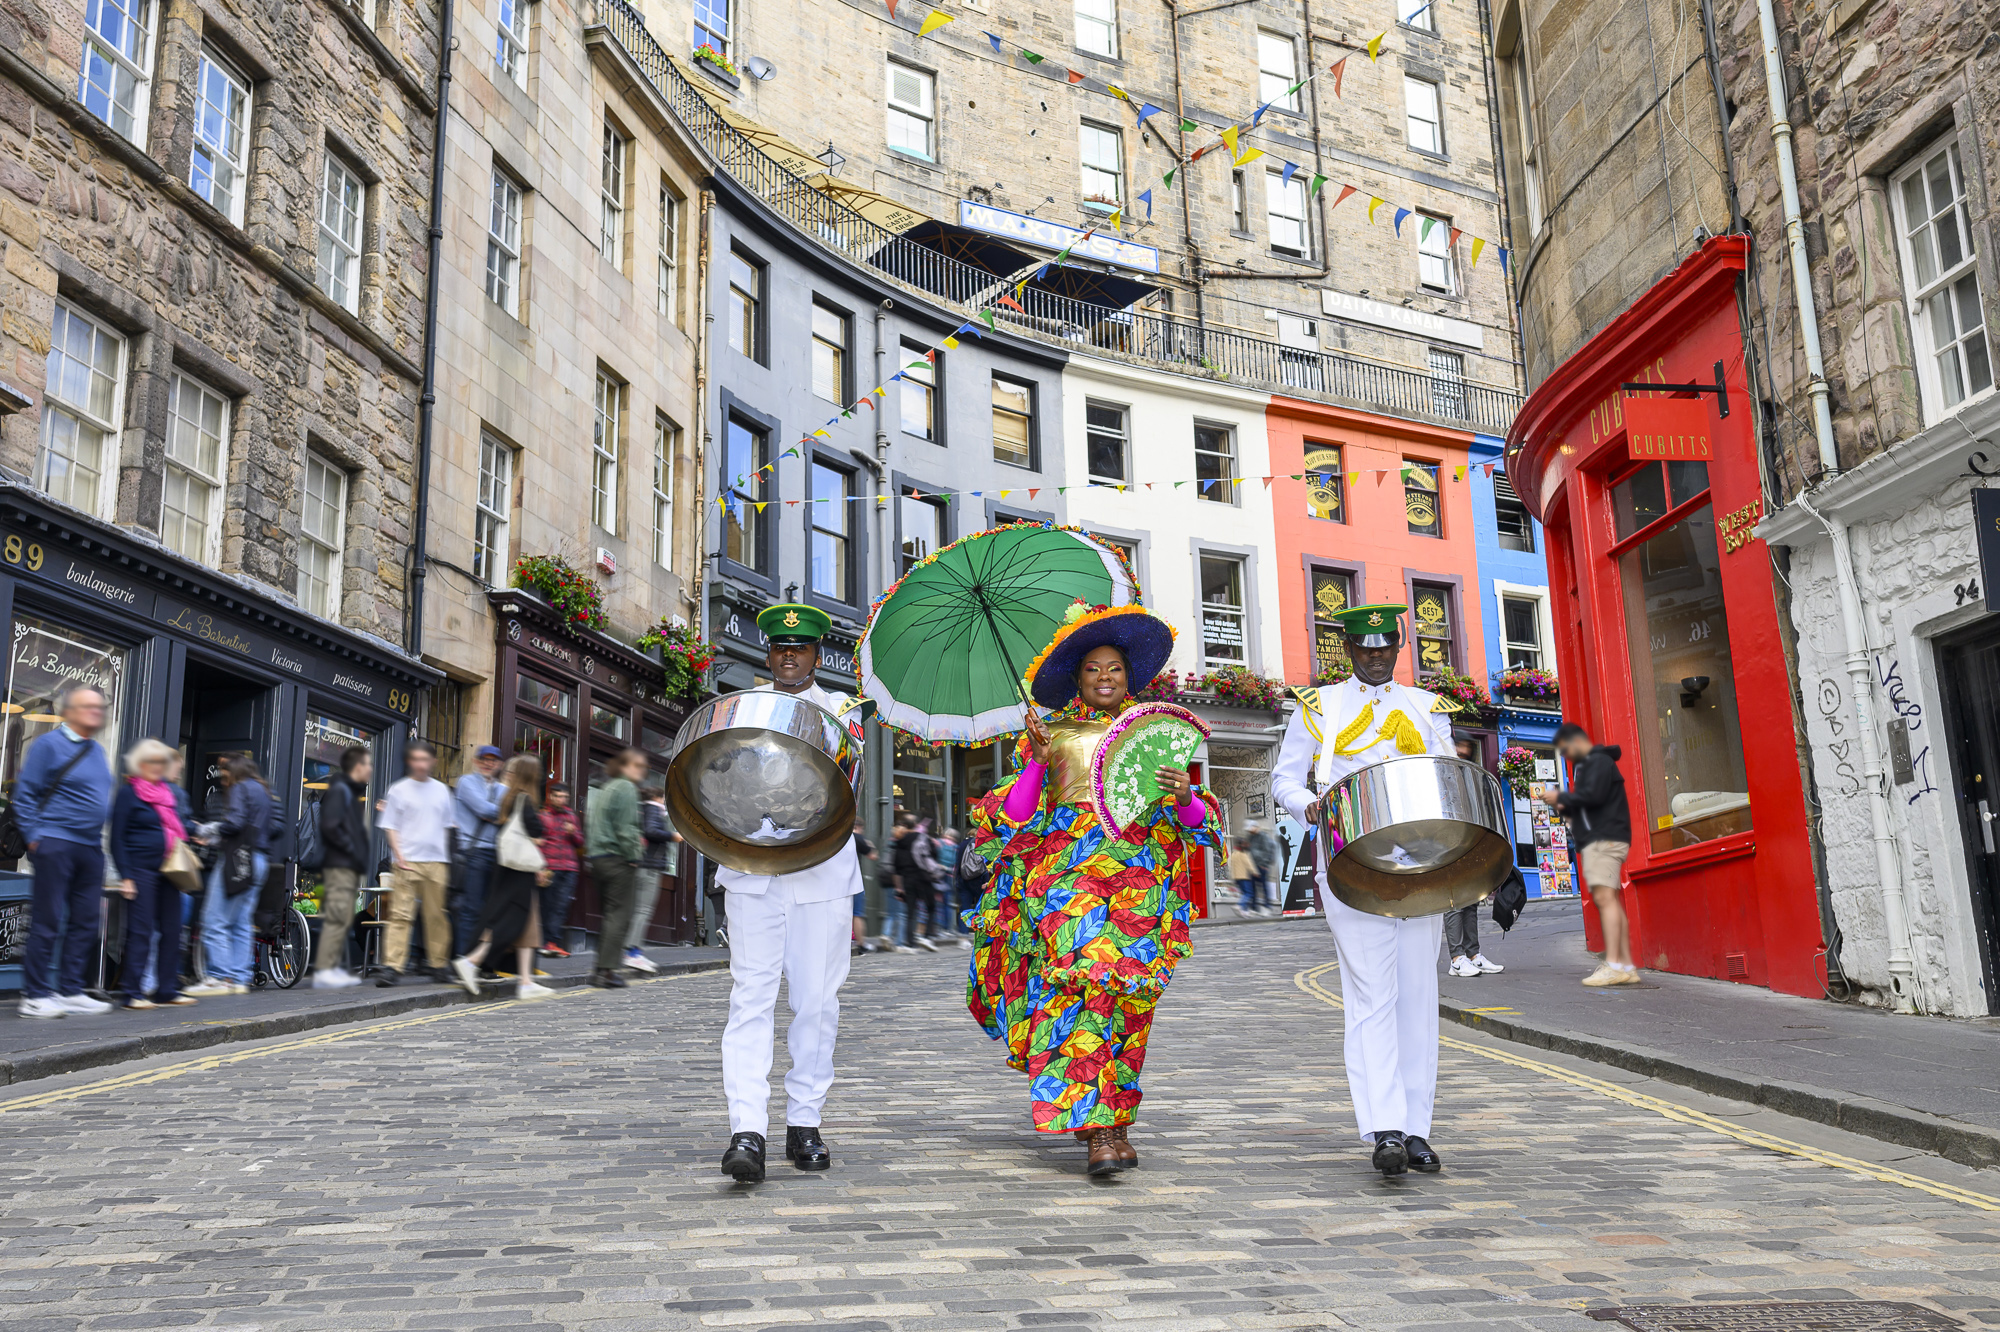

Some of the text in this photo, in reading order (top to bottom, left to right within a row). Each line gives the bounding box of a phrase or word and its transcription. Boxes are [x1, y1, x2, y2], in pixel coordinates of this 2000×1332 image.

[885, 211, 902, 221] THE
[885, 214, 914, 228] CASTLE
[895, 221, 915, 232] ARMS
[1330, 291, 1446, 332] DAIKA KANAM
[1590, 357, 1666, 445] CUBTTS
[1633, 434, 1708, 456] CUBITTS
[1718, 500, 1760, 538] WEST
[1319, 591, 1342, 603] ORIGINAL
[1953, 577, 1979, 606] 94
[1422, 606, 1439, 617] BEST
[4, 534, 410, 714] 89 boulangerie La Barantine Victoria patisserie 89
[16, 644, 109, 689] La Barantine
[821, 649, 853, 672] later
[1209, 719, 1268, 729] www.edinburghart.com
[1453, 720, 1483, 728] erchandise
[907, 748, 930, 758] KNITWEAR
